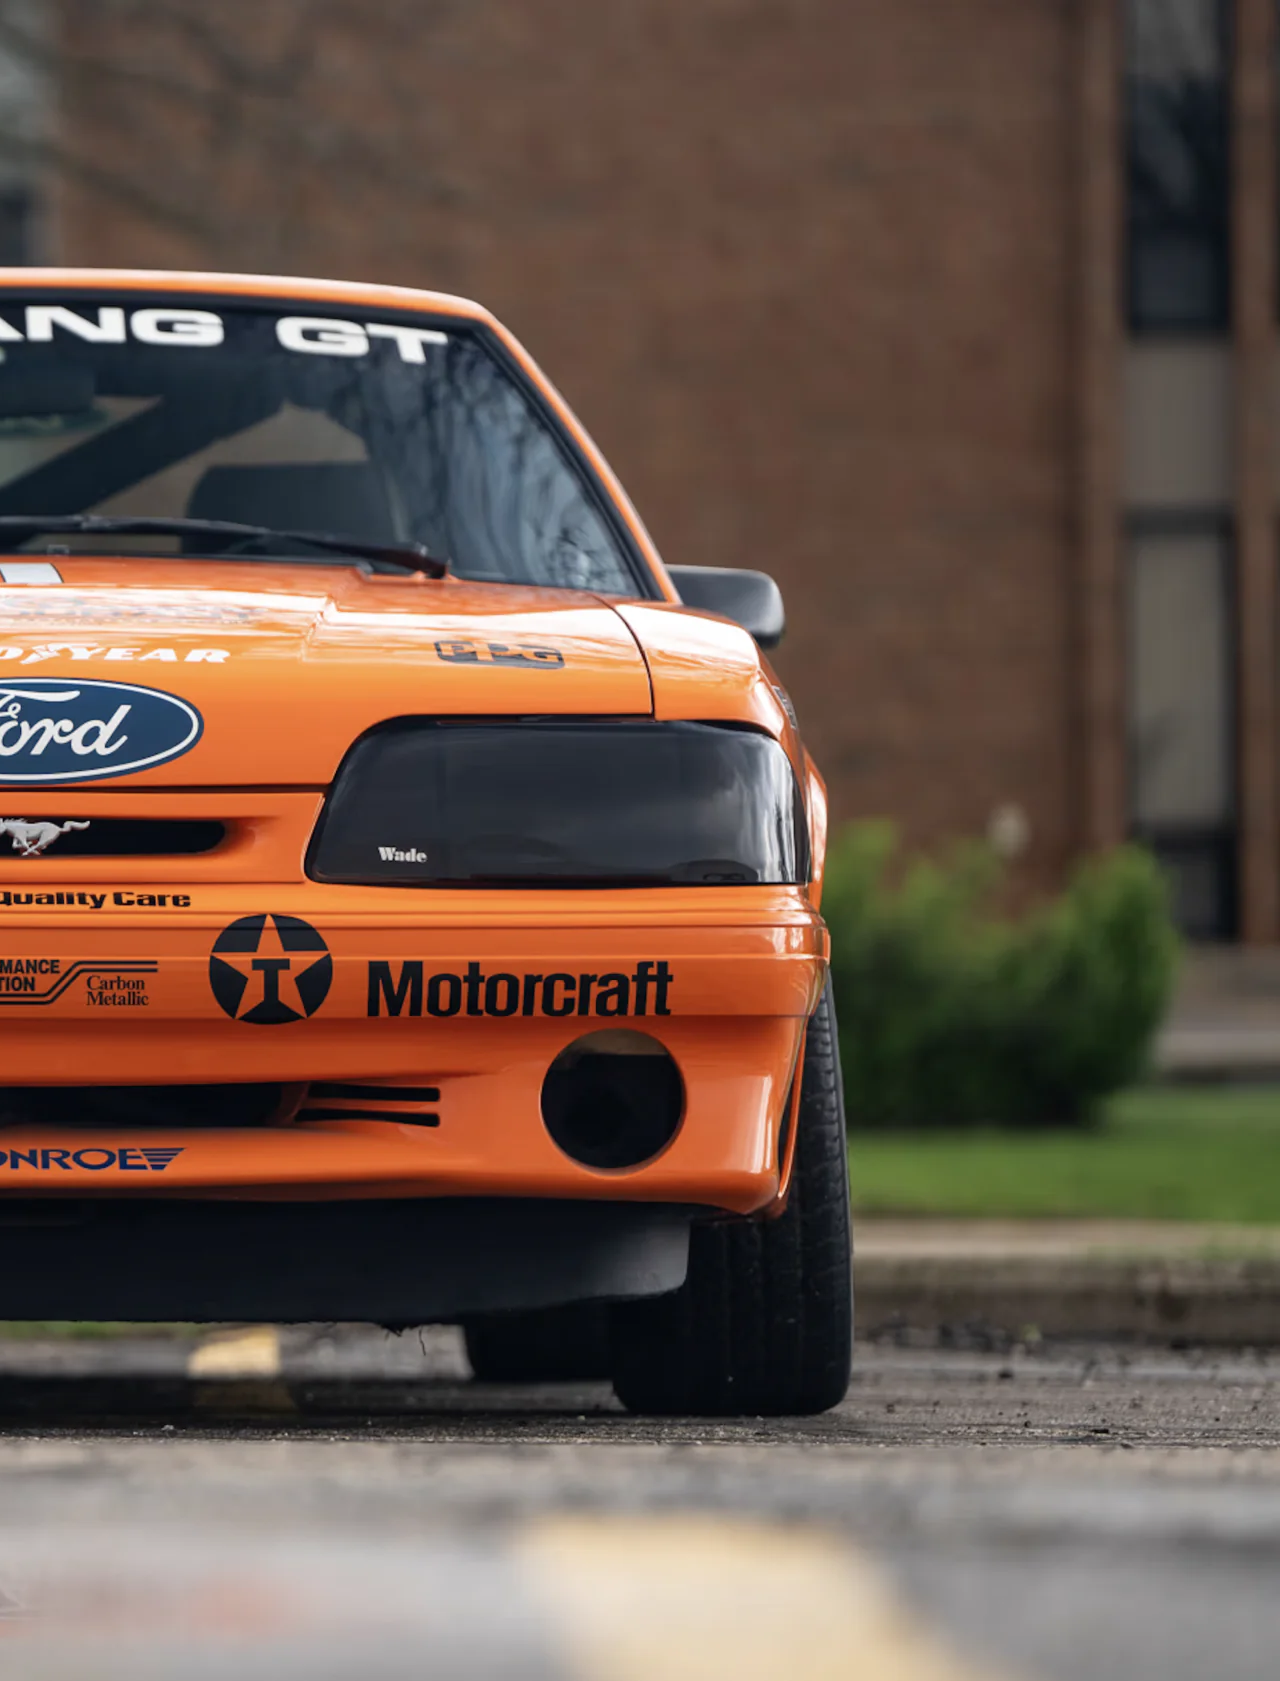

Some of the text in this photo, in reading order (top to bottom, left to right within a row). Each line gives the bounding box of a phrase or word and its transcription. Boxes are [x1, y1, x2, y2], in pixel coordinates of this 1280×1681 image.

[275, 318, 449, 365] GT
[435, 640, 565, 669] PPG
[378, 846, 427, 864] Wade
[113, 891, 192, 908] Care
[86, 975, 146, 991] Carbon
[251, 957, 291, 1004] T
[367, 960, 673, 1018] Motorcraft
[86, 991, 149, 1006] Metallic
